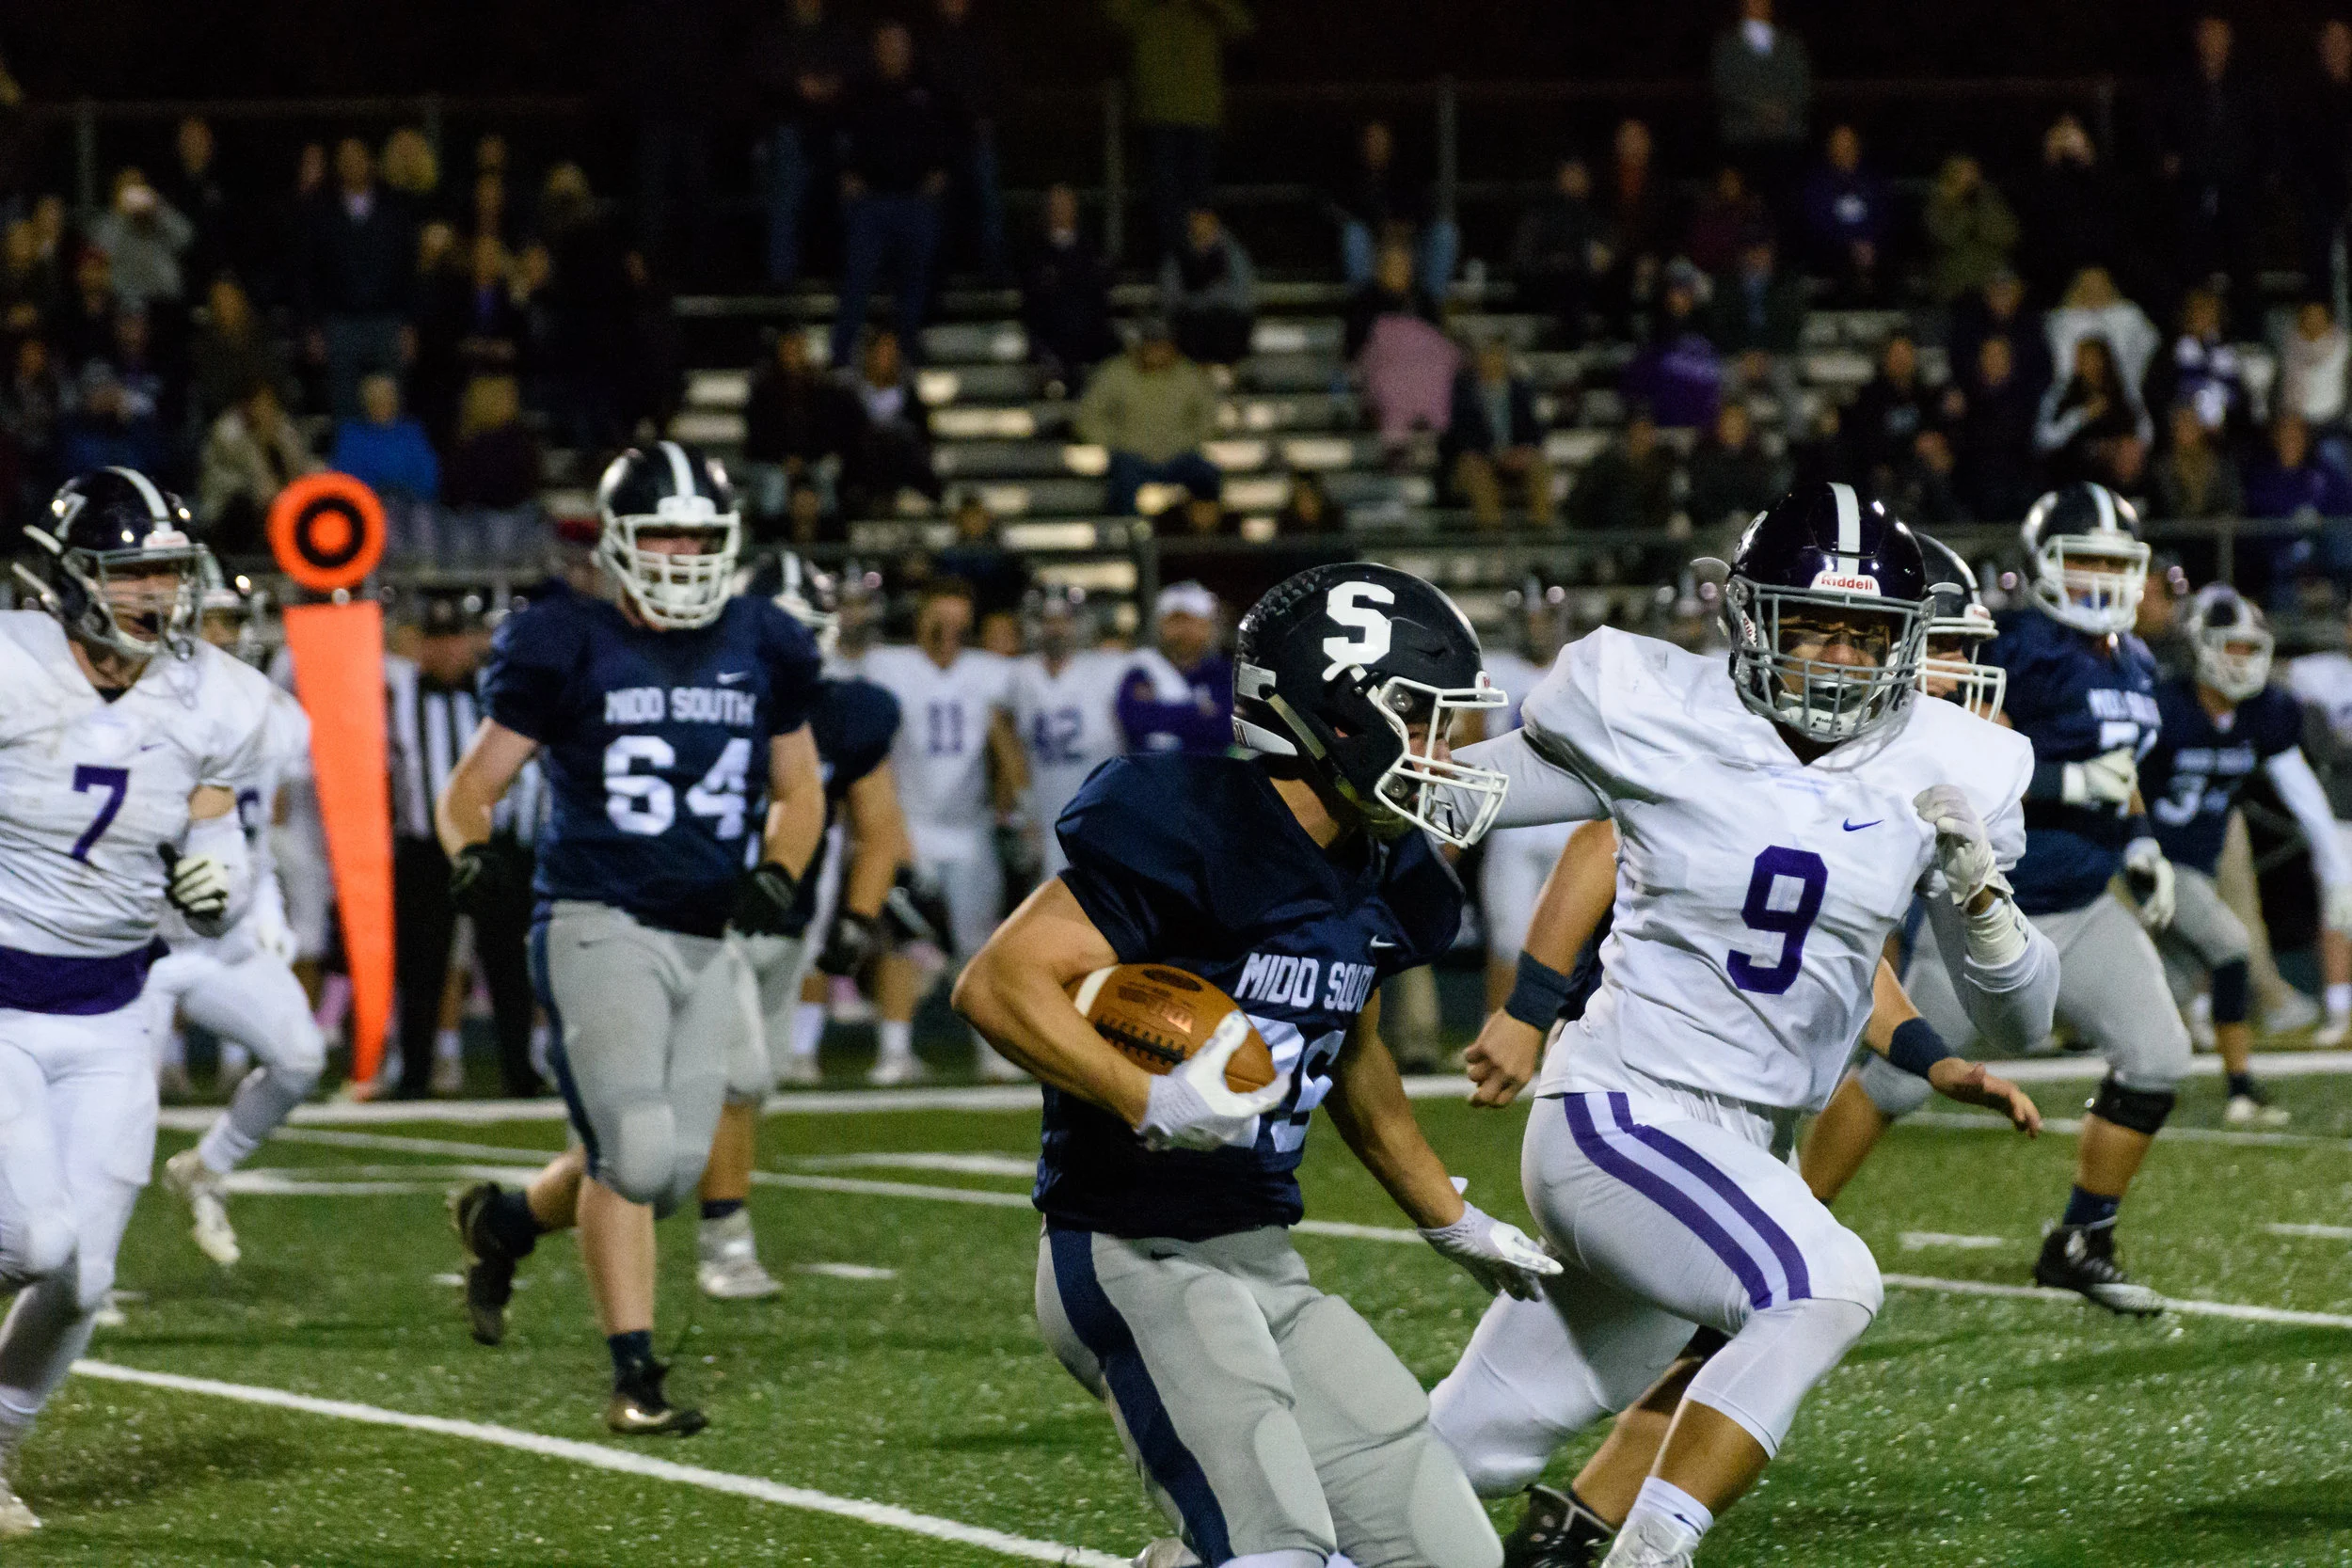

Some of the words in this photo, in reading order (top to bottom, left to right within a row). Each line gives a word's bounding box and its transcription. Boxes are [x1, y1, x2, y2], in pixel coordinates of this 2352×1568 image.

[1323, 581, 1395, 664] S
[1820, 575, 1873, 591] Riddell
[671, 687, 756, 725] SOUTH
[73, 764, 128, 863] 7
[605, 736, 752, 840] 64
[1726, 845, 1828, 995] 9
[1233, 953, 1319, 1008] MIDD
[1324, 961, 1376, 1013] SOUT
